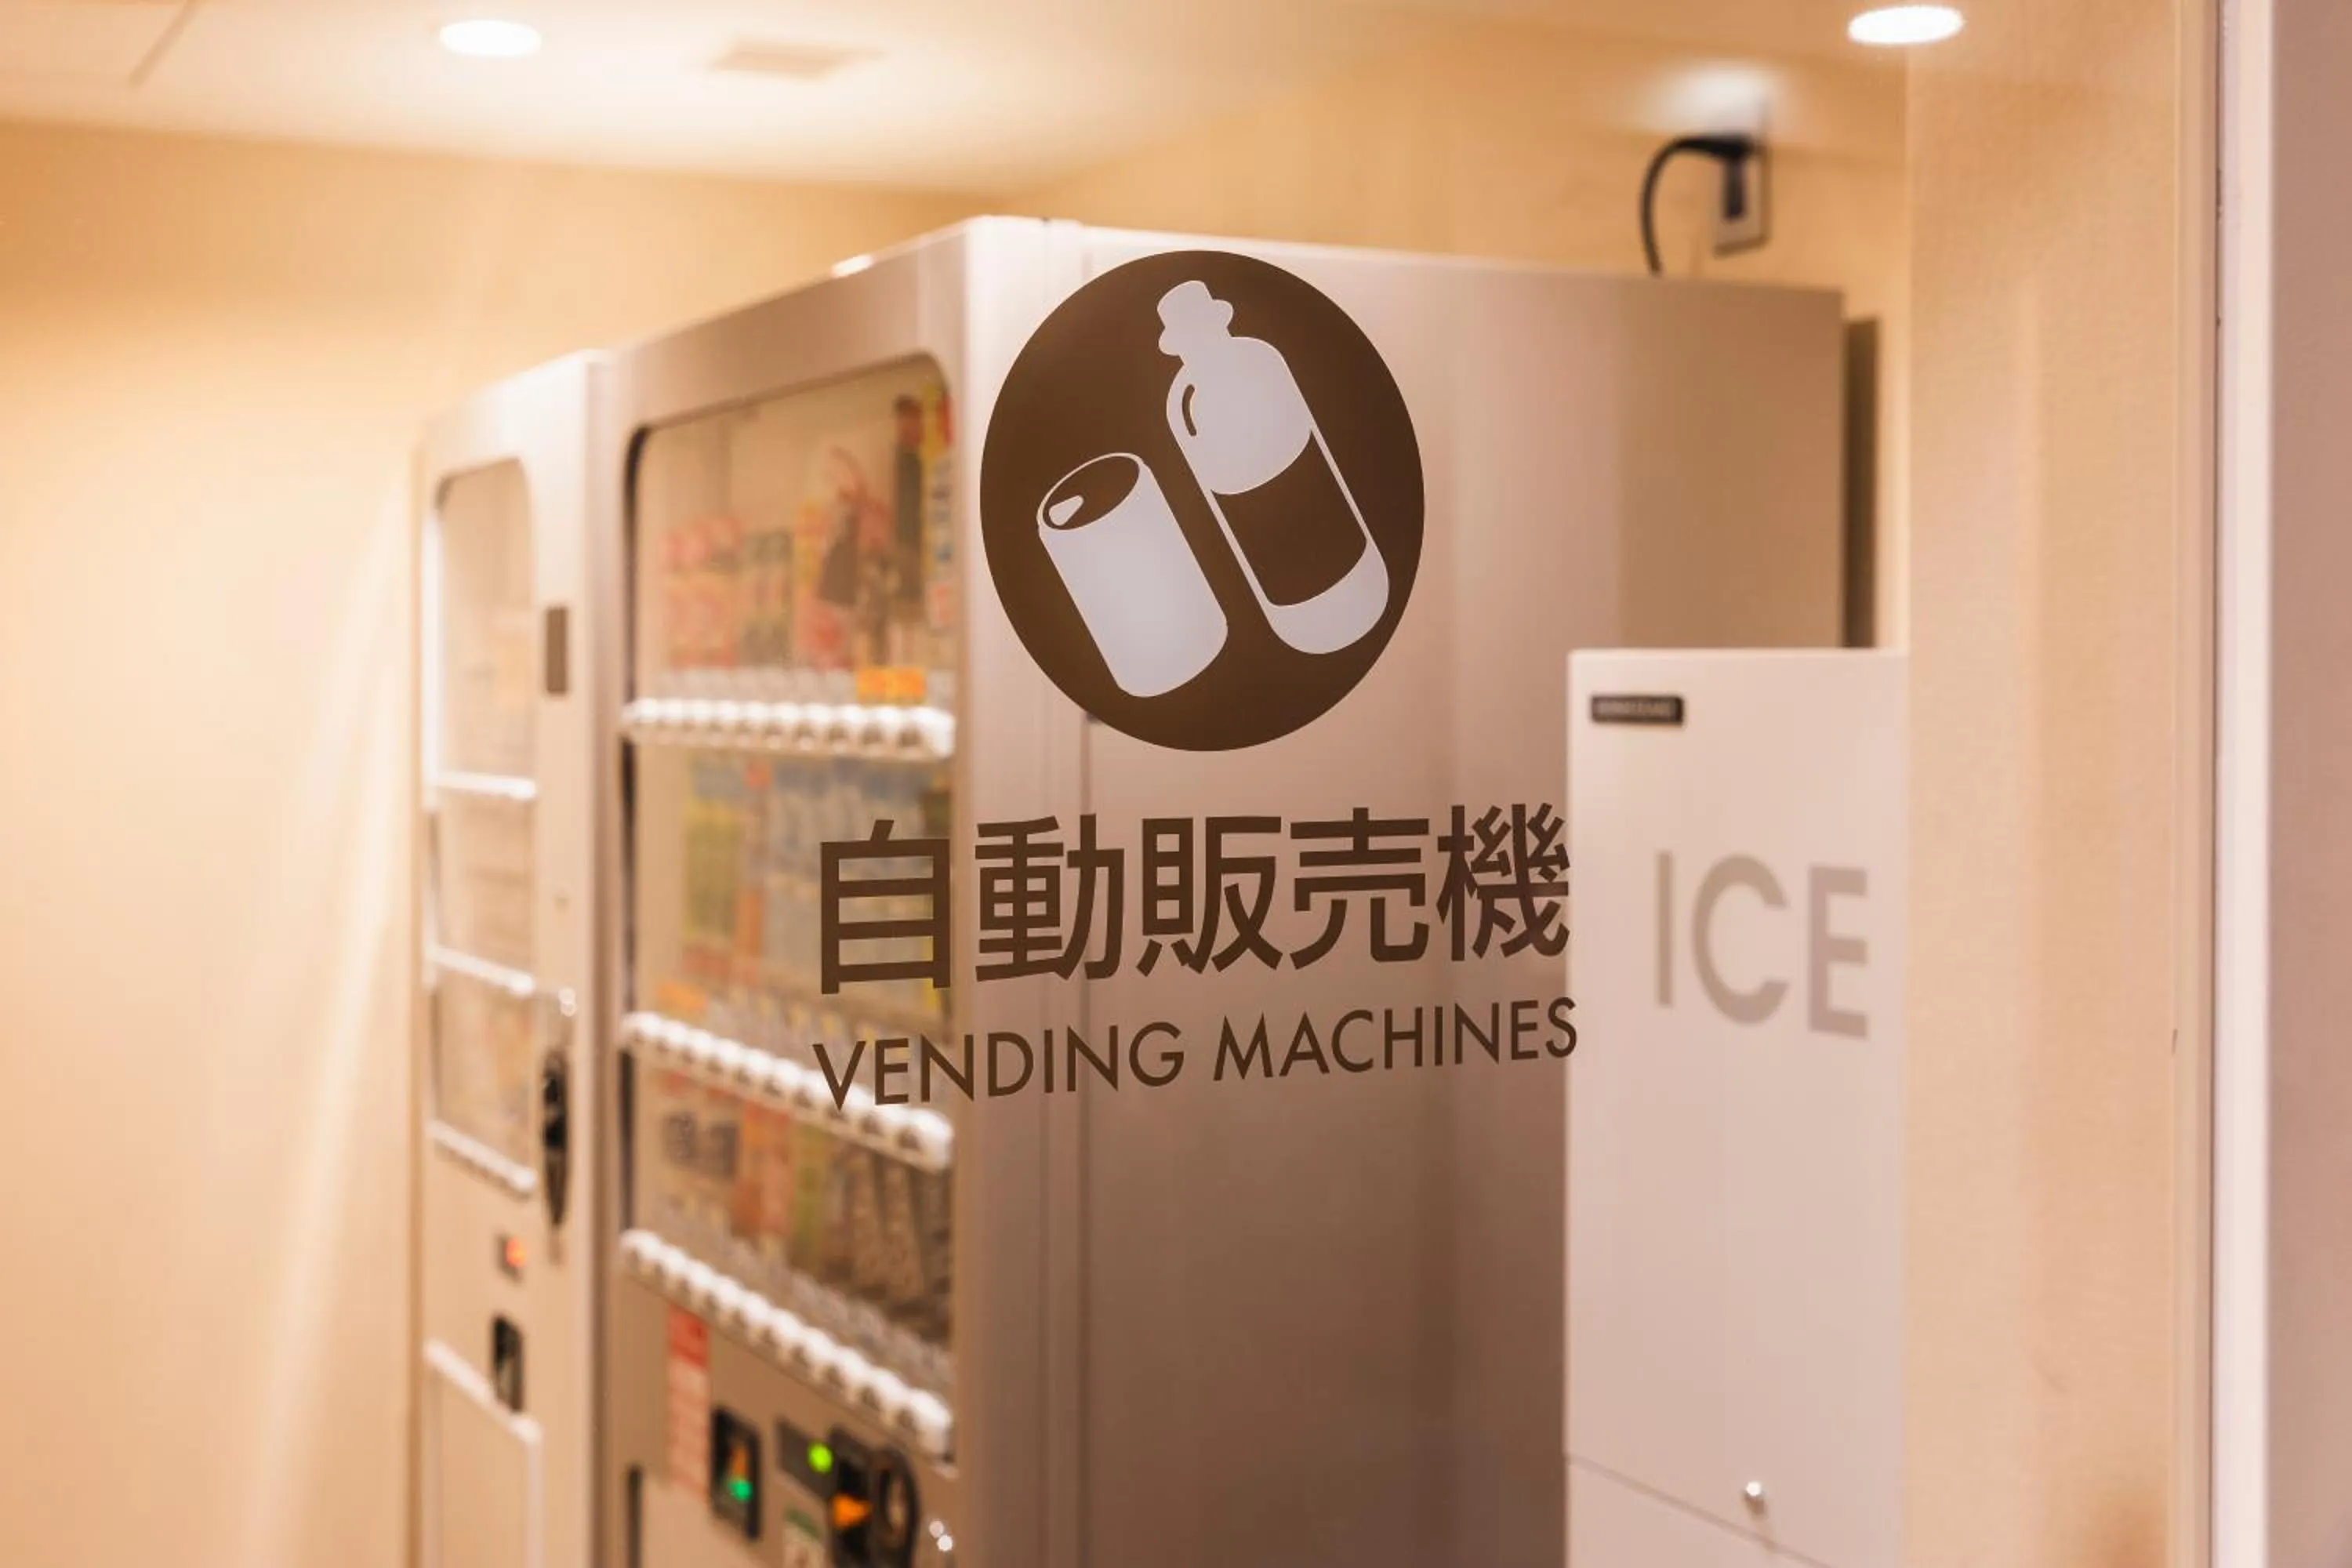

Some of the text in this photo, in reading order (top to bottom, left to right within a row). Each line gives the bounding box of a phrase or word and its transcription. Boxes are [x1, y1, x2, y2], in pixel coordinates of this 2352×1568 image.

[820, 802, 1570, 995] 自動販売機
[1656, 851, 1869, 1038] ICE
[813, 996, 1577, 1111] VENDING MACHINES
